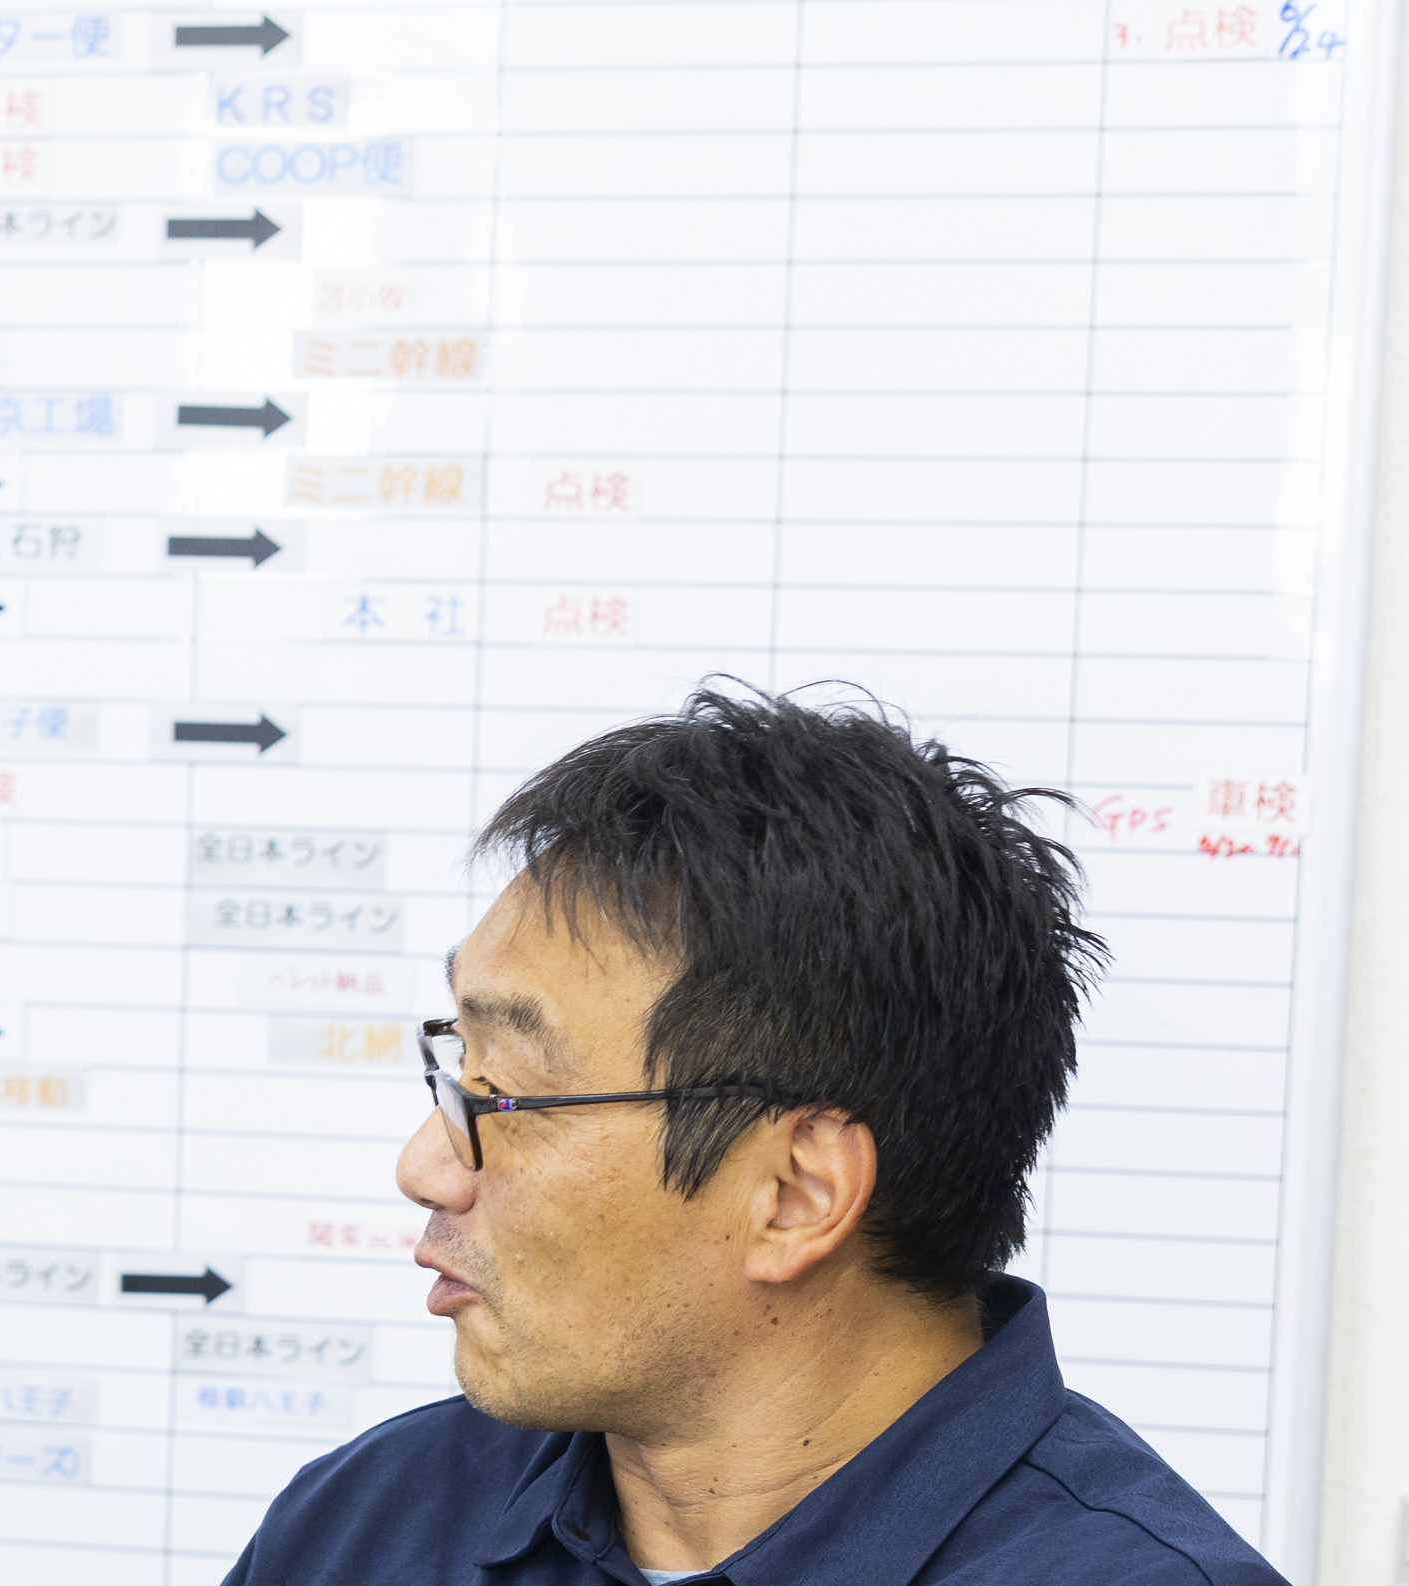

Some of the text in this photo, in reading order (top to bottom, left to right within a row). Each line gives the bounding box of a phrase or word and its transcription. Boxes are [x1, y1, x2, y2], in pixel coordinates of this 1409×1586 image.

[1164, 4, 1258, 52] 点検
[216, 85, 337, 124] KRS
[216, 141, 403, 186] COOP便
[302, 336, 477, 378] ミニ幹線
[293, 463, 464, 503] ミニ幹線
[545, 470, 630, 511] 点検
[543, 596, 629, 636] 点検
[1206, 779, 1299, 822] 車検
[196, 833, 379, 870] 全日本ライン
[215, 898, 400, 934] 全日本ライン
[184, 1329, 365, 1366] 全日本ライン
